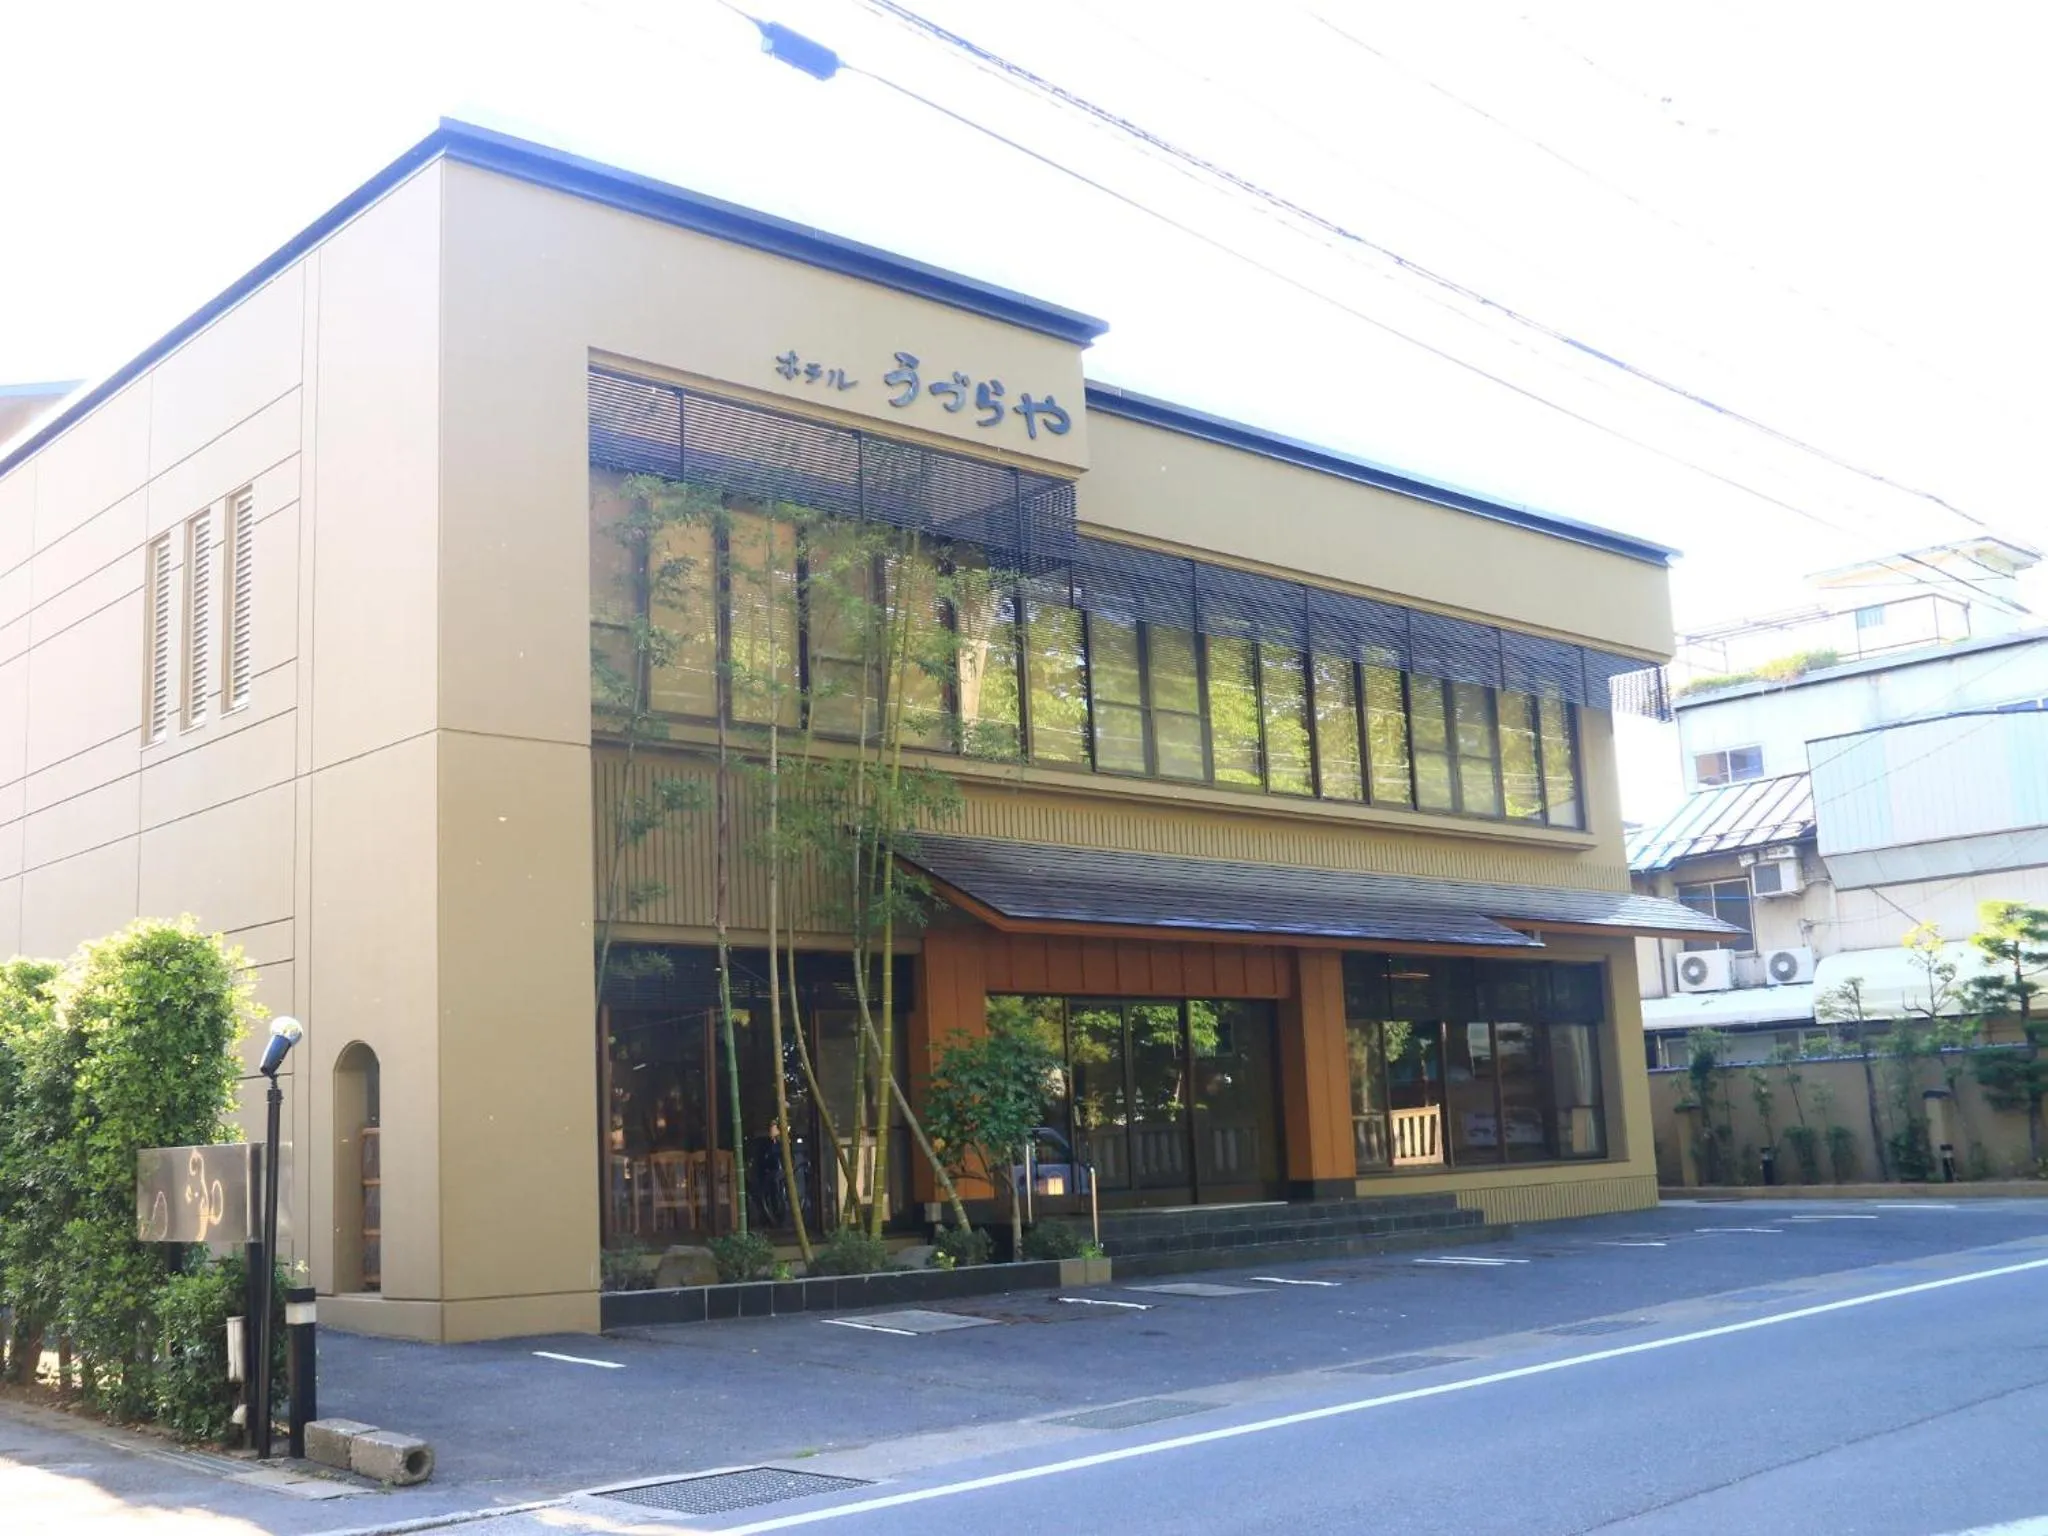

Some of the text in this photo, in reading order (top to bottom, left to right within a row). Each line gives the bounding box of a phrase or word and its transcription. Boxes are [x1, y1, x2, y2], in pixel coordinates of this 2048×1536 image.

[775, 349, 1072, 440] ホテル うづらや
